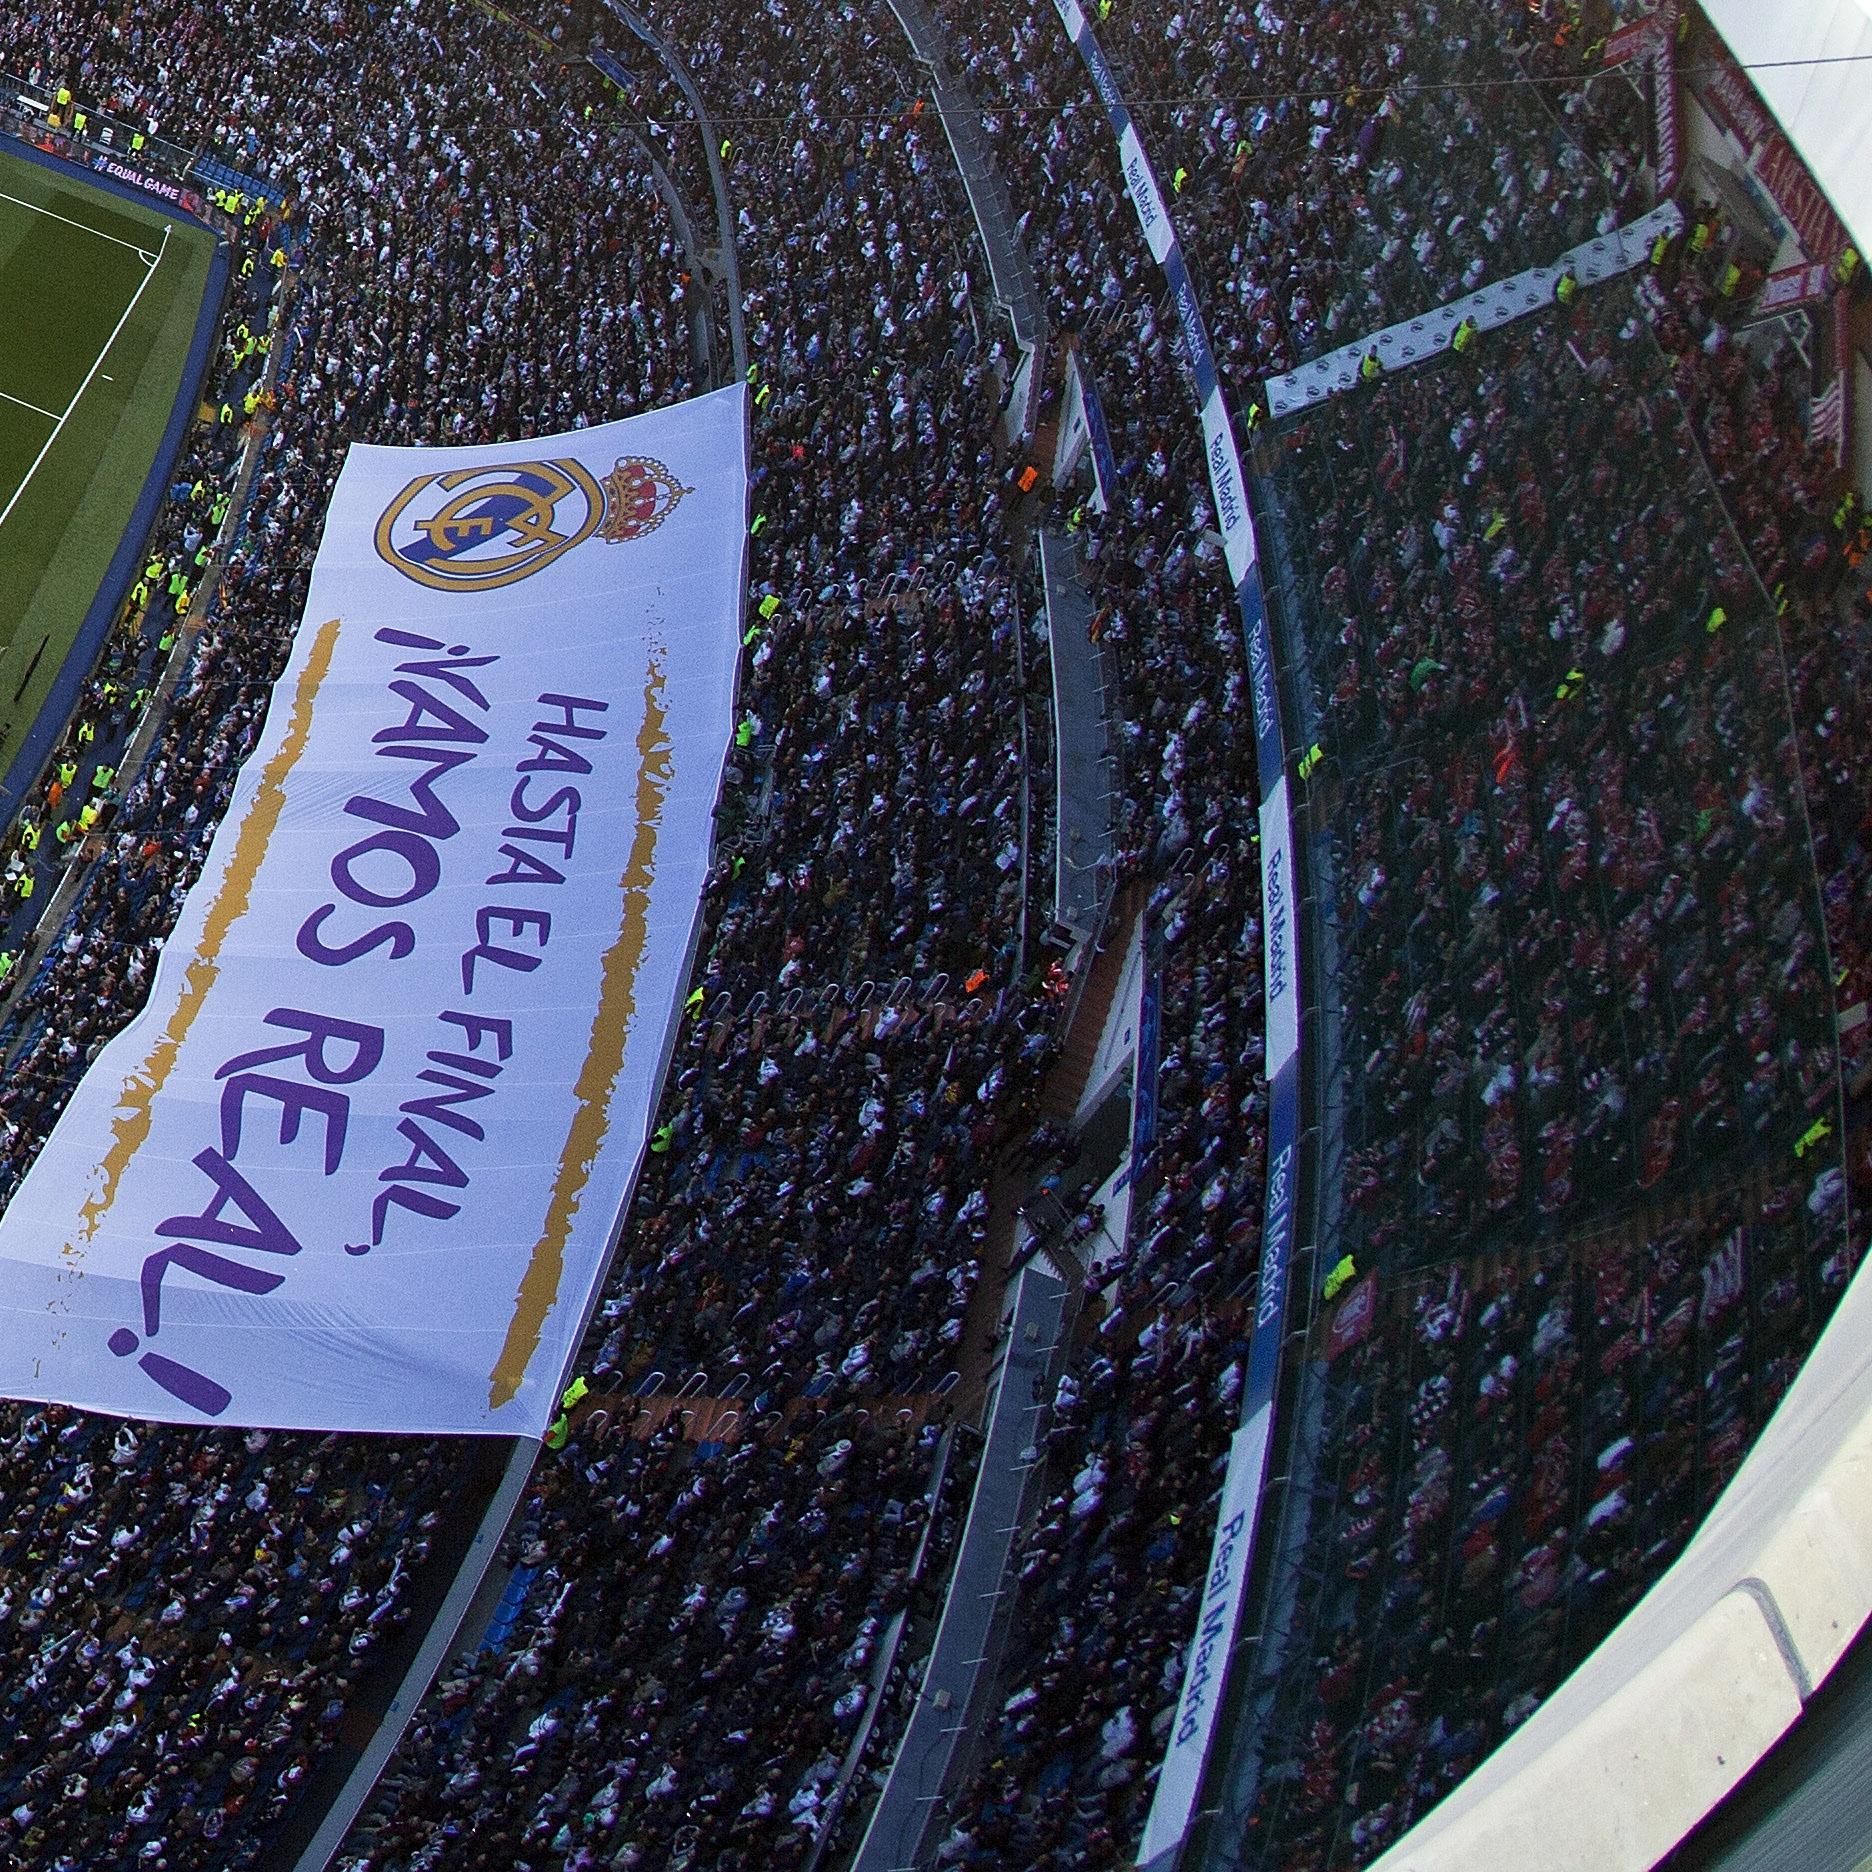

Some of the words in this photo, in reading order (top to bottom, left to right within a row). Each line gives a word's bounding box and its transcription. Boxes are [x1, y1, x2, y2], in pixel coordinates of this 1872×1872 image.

[143, 173, 181, 201] GAME
[1125, 157, 1143, 184] Real
[1134, 180, 1156, 229] Madrid
[1209, 430, 1226, 475] Real
[1215, 468, 1239, 531] Madrid
[295, 626, 501, 968] ¡VAMOS
[485, 692, 610, 886] HASTA
[461, 905, 553, 997] EL
[106, 1007, 386, 1418] REAL!
[1209, 1508, 1246, 1600] Real
[1175, 1598, 1227, 1747] Madrid
